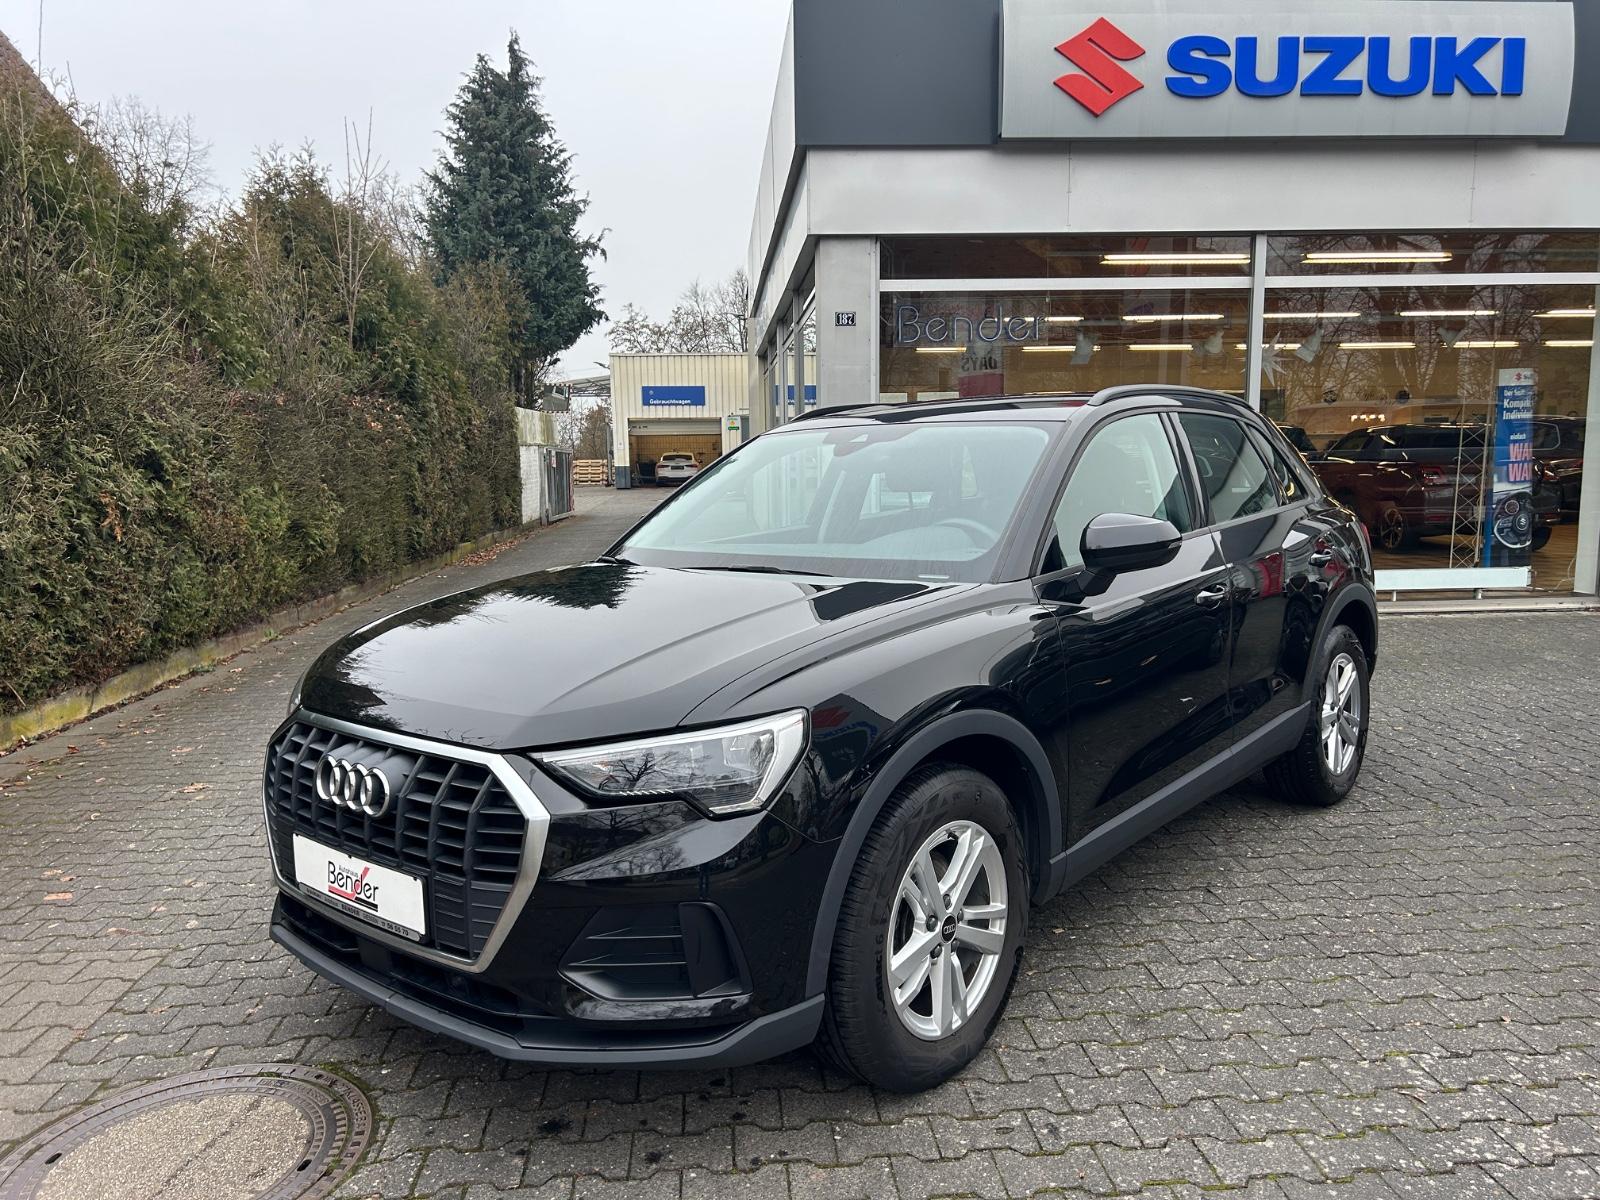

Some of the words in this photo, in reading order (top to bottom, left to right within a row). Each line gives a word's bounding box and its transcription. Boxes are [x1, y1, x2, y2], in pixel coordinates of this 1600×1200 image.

[1165, 36, 1526, 97] SUZUKI
[837, 313, 853, 325] 187
[898, 304, 1045, 343] Bender
[327, 860, 379, 902] Bender
